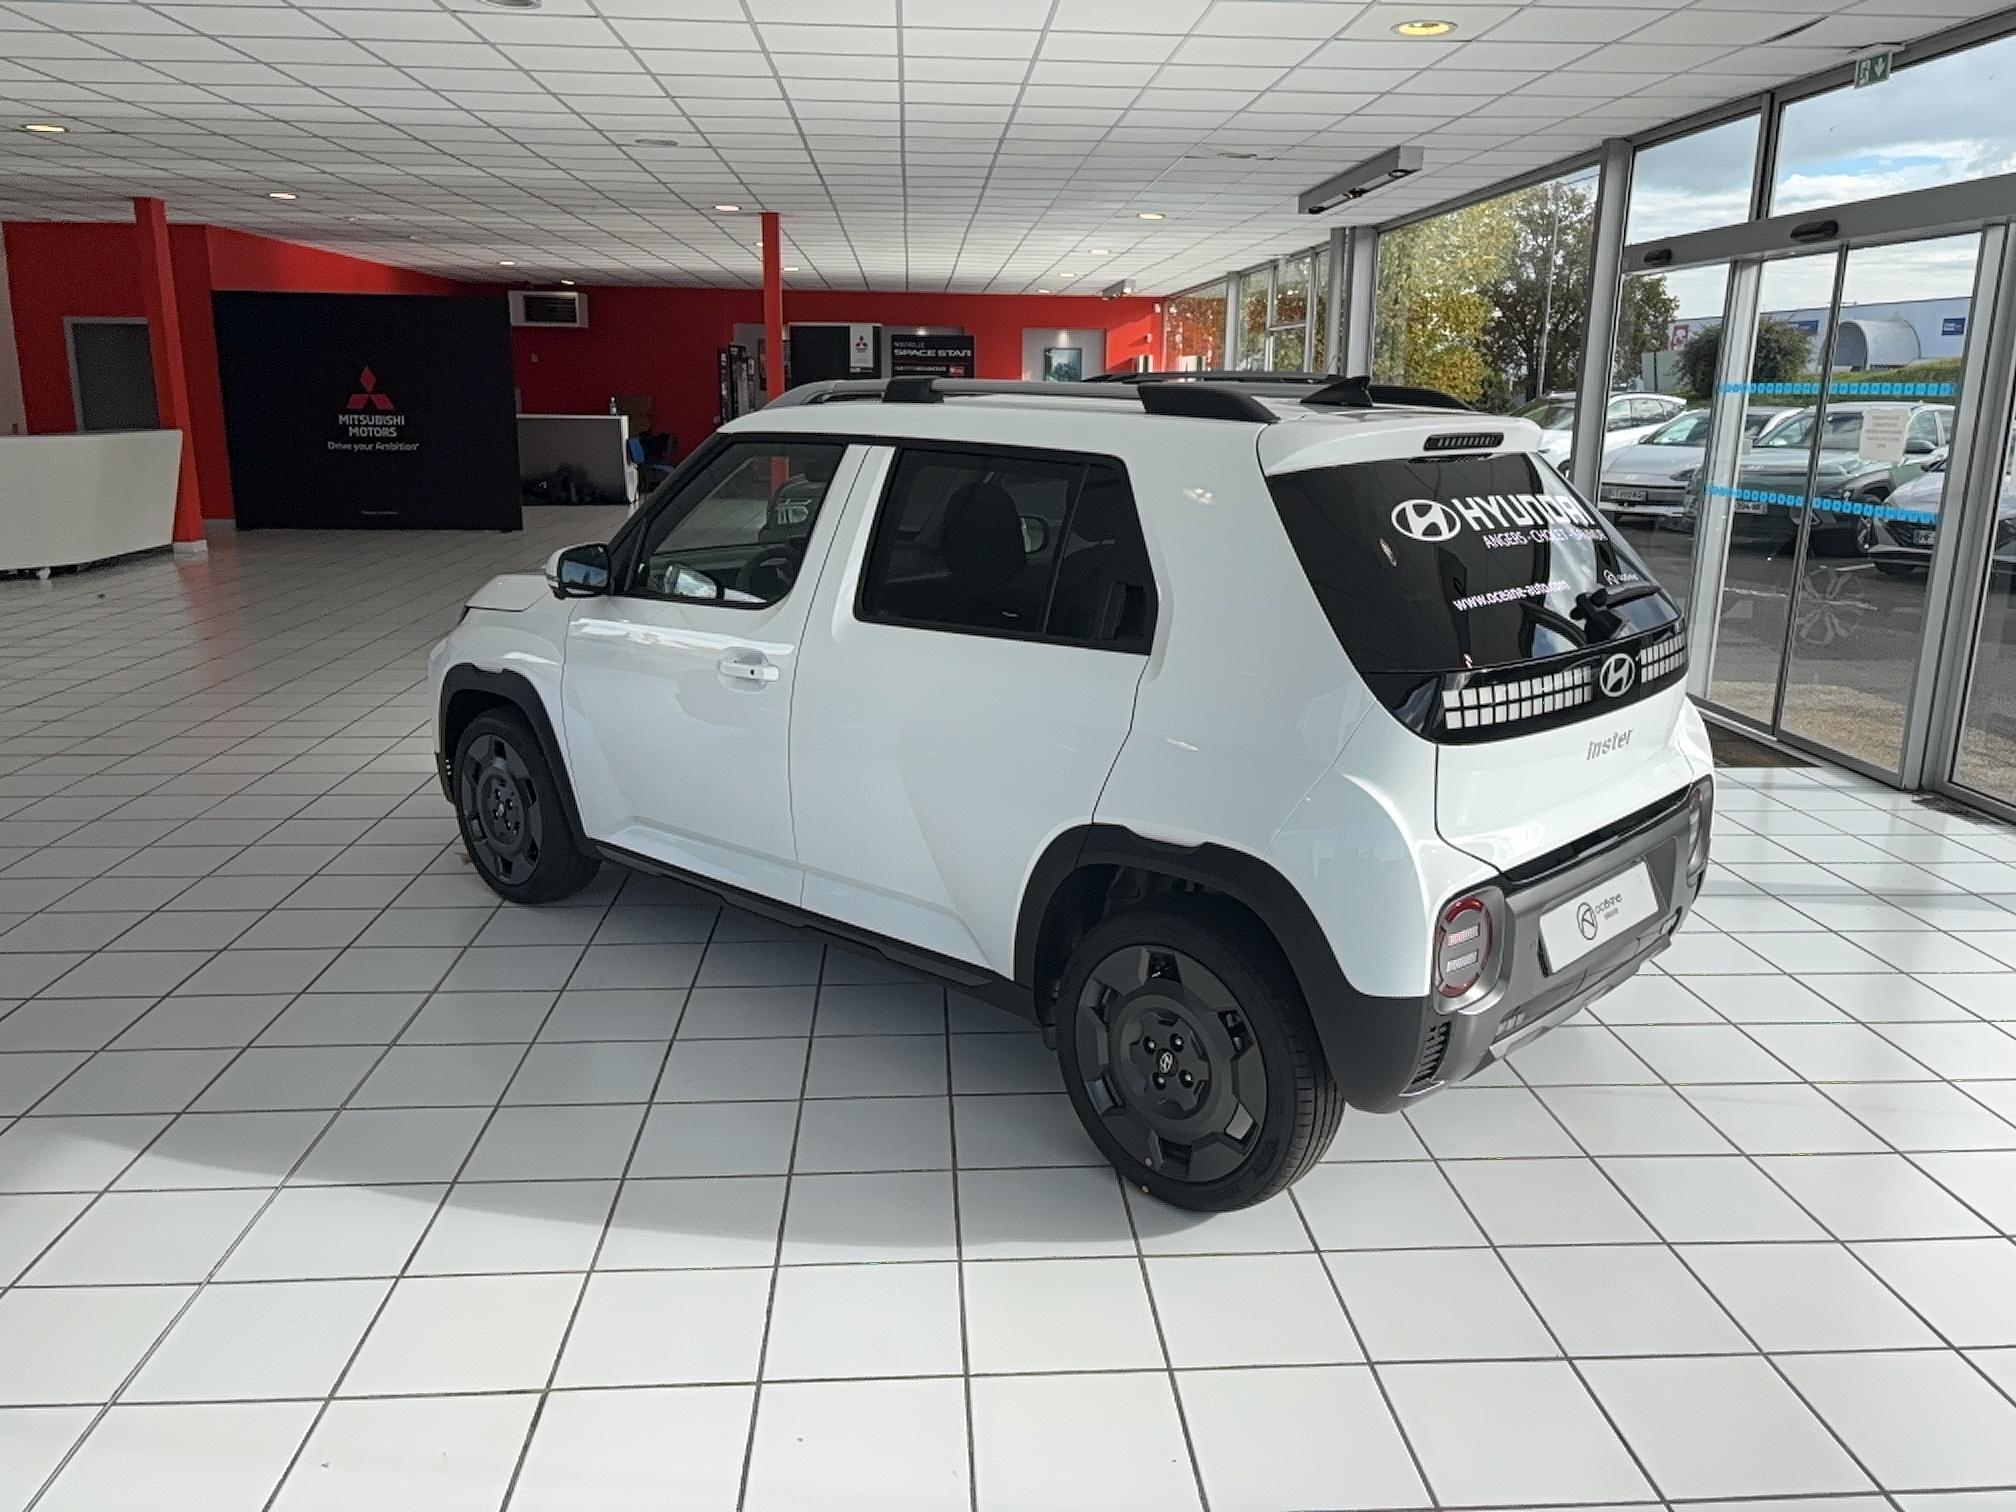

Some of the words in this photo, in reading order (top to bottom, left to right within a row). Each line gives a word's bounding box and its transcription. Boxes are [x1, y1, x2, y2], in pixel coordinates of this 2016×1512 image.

[894, 349, 937, 357] SPACE
[938, 349, 972, 357] STAR
[338, 414, 405, 425] MITSUBISHI
[348, 426, 397, 437] MOTORS
[327, 441, 352, 450] Drive
[353, 443, 374, 453] your
[1451, 494, 1596, 531] HYUNDAI
[1483, 531, 1528, 549] ANGERS
